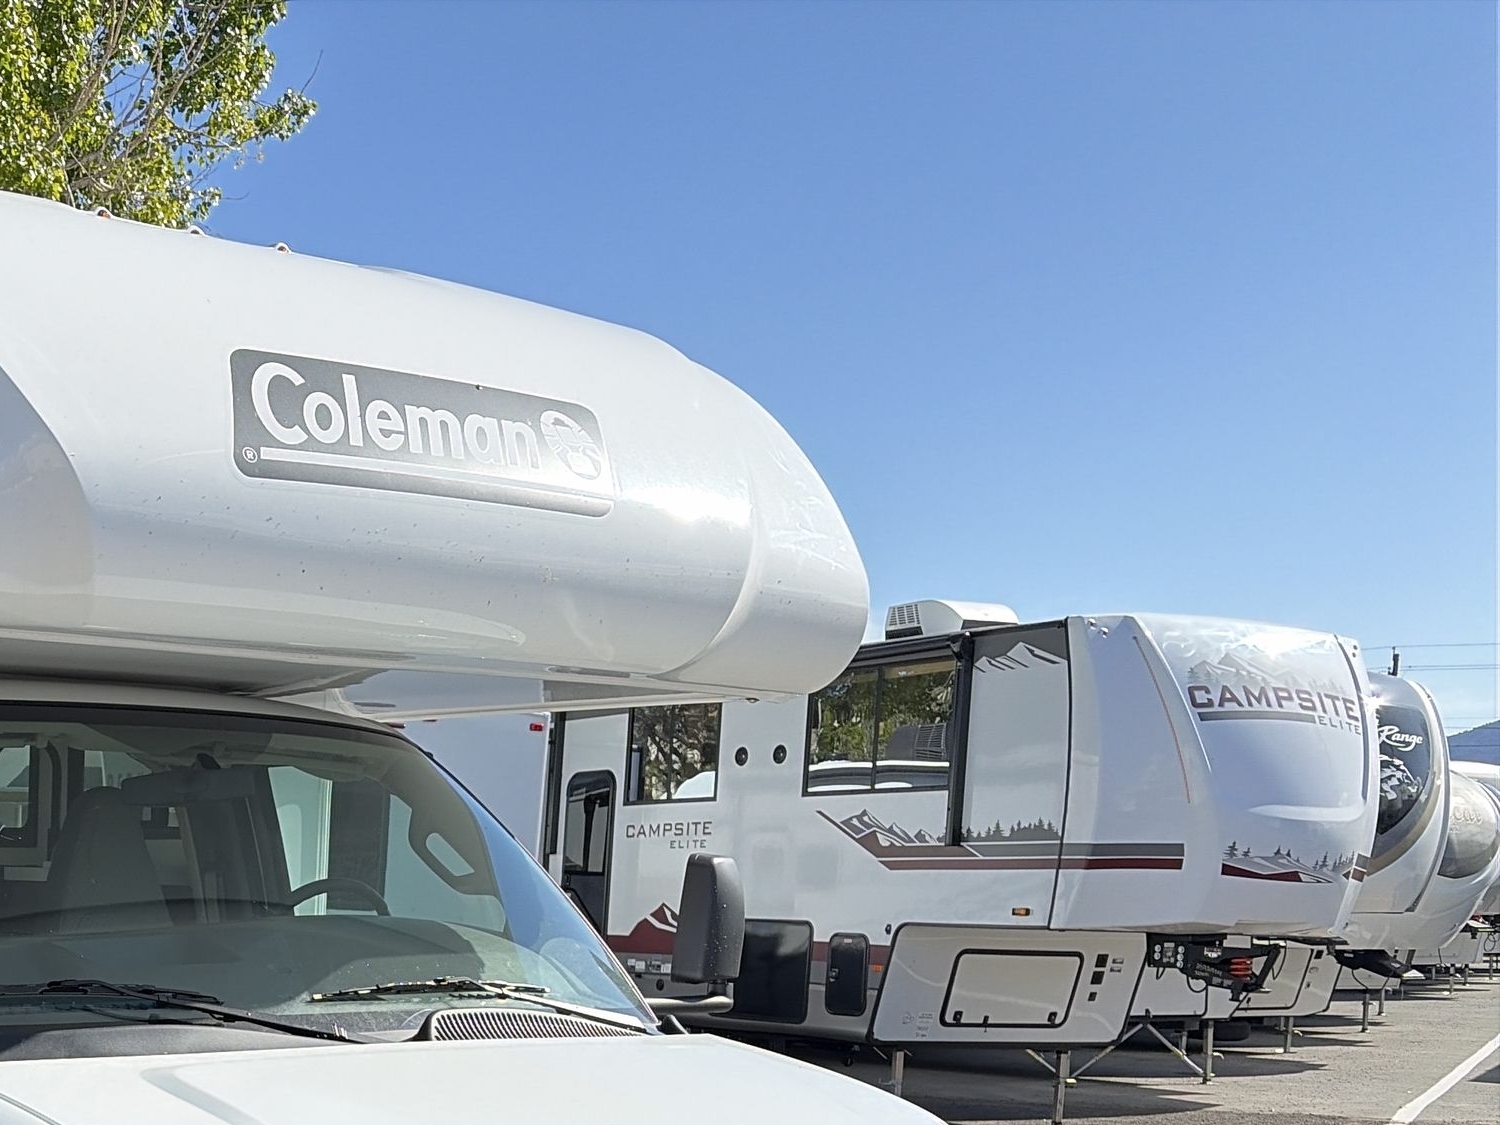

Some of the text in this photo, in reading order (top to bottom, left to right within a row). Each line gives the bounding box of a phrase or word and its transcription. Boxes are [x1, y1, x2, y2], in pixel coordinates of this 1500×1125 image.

[251, 361, 541, 470] Coleman
[1187, 684, 1360, 723] CAMPSITE
[1318, 715, 1362, 736] ELITE
[1377, 725, 1423, 752] Range
[626, 821, 713, 839] CAMPSITE
[669, 839, 707, 849] ELITE
